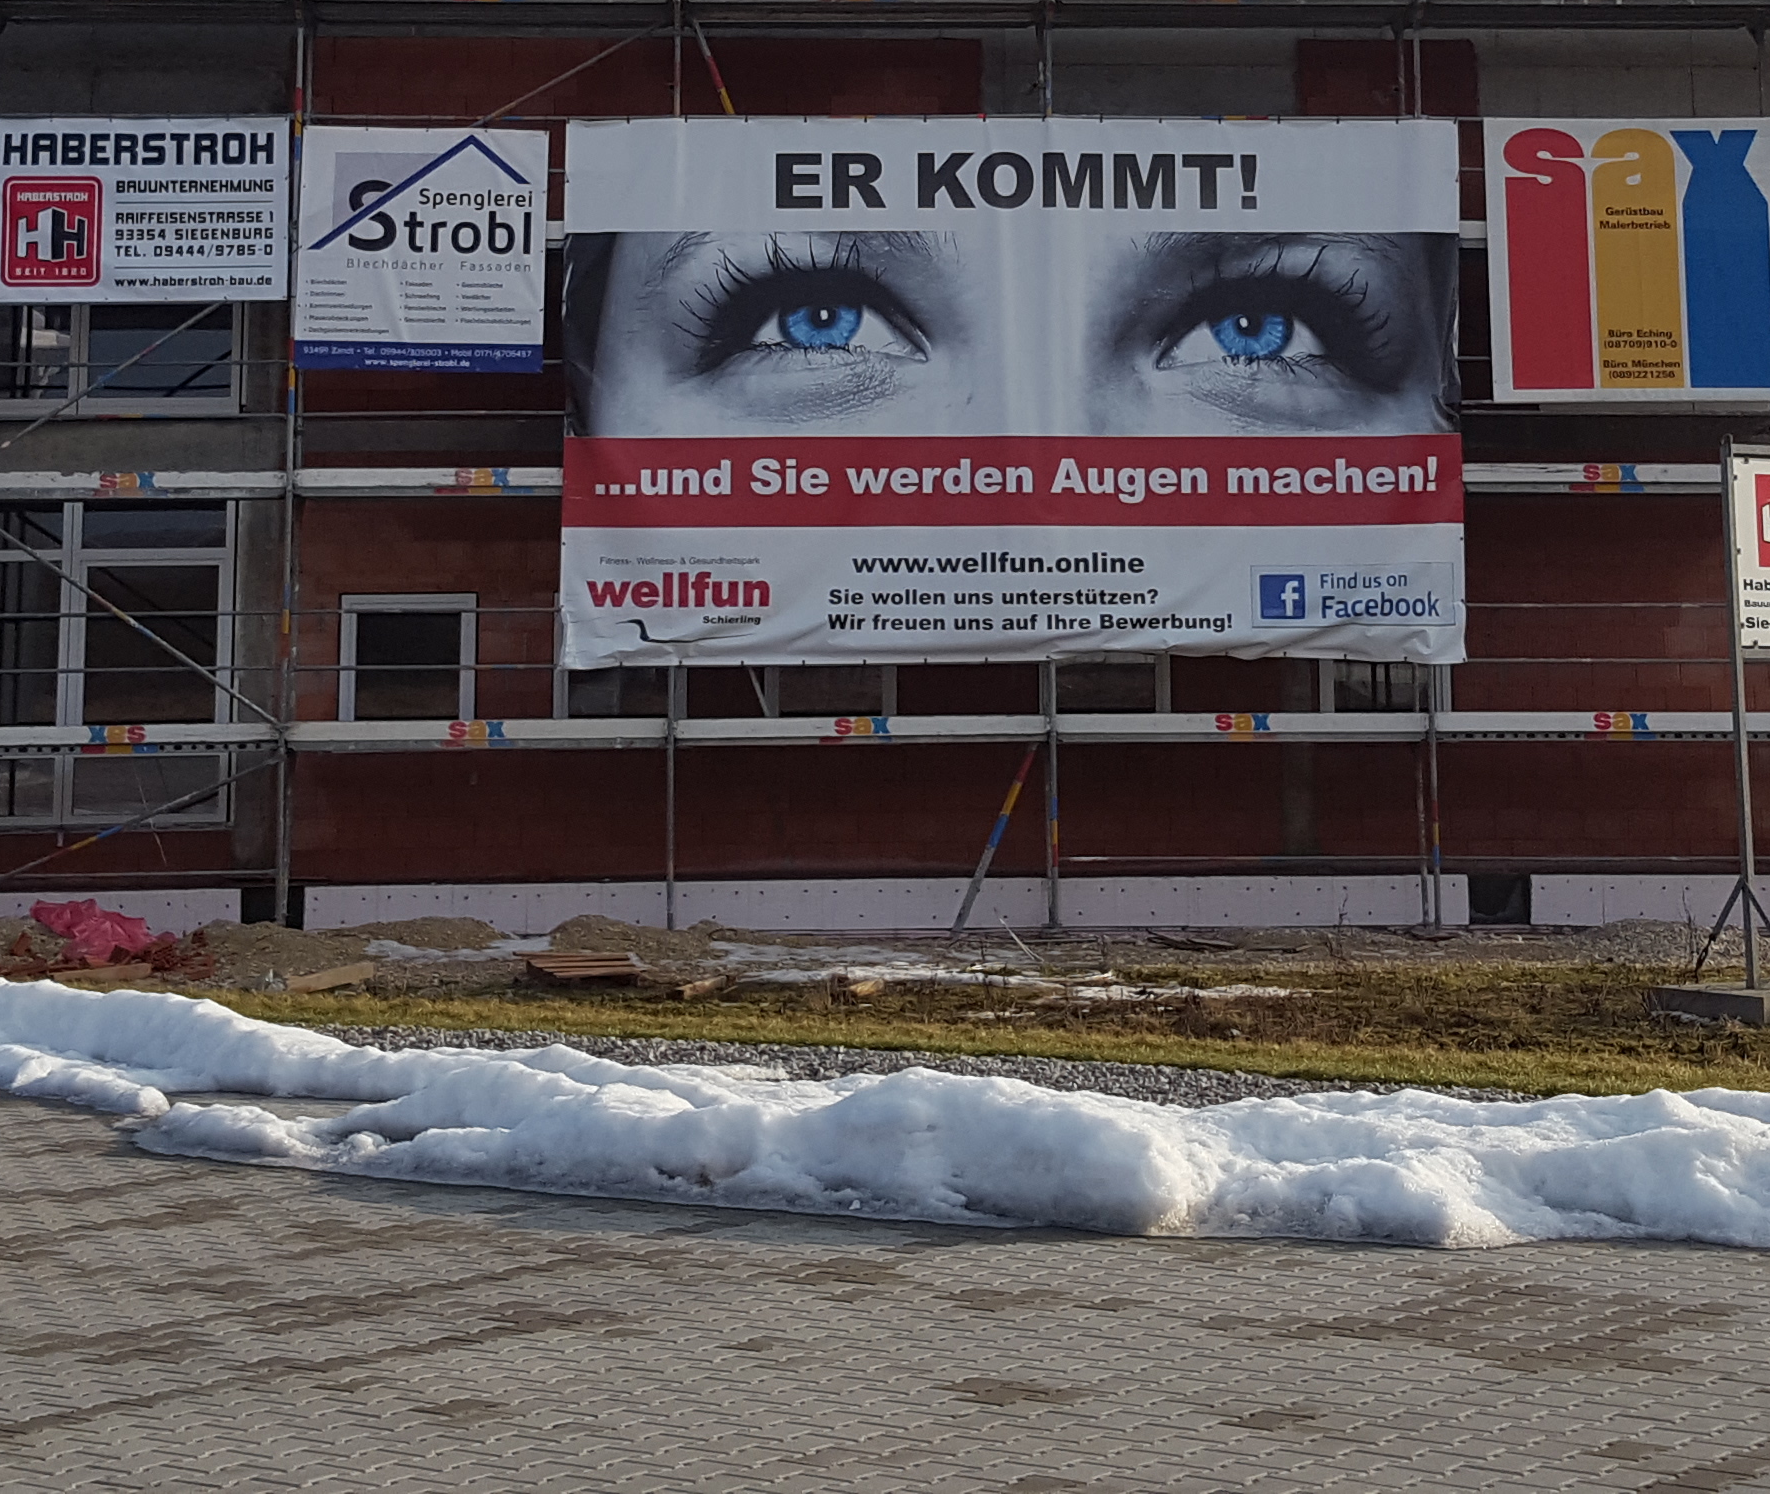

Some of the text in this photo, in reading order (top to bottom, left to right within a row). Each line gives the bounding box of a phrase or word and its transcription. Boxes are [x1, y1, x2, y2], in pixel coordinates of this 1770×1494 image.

[2, 132, 275, 166] HABERSTROH
[116, 179, 274, 194] BAUUNTERNEHMUNG
[775, 152, 1259, 210] ER KOMMT!
[17, 192, 89, 202] HABERSTROH
[419, 187, 533, 210] Spenglerei
[115, 211, 264, 224] RAIFFEISENSTRASSE
[348, 180, 532, 255] Strobl
[1605, 206, 1664, 216] Gerüstbau
[1599, 220, 1671, 230] Malerbetrieb
[115, 228, 274, 241] 93354 SIEGENBURG
[115, 244, 273, 258] TEL. 09444/9785-0
[114, 275, 272, 287] www.haberstroh-bau.de
[1608, 329, 1672, 340] Büro Eching
[1603, 359, 1681, 368] Büro München
[100, 472, 158, 488] sax
[595, 456, 1438, 504] ...und Sie werden Augen machen!
[1583, 464, 1639, 480] sax
[852, 552, 1145, 574] www.wellfun.online
[1320, 572, 1408, 589] Find us on
[586, 571, 771, 609] wellfun
[828, 589, 1159, 605] Sie wollen uns unterstützen?
[1321, 592, 1440, 619] Facebook
[703, 615, 761, 626] Schierling
[828, 614, 1233, 633] Wir freuen uns auf Ihre Bewerbung!
[448, 721, 505, 738] sax
[834, 717, 891, 734] sax
[1214, 714, 1271, 730] sax
[1593, 713, 1649, 730] sax
